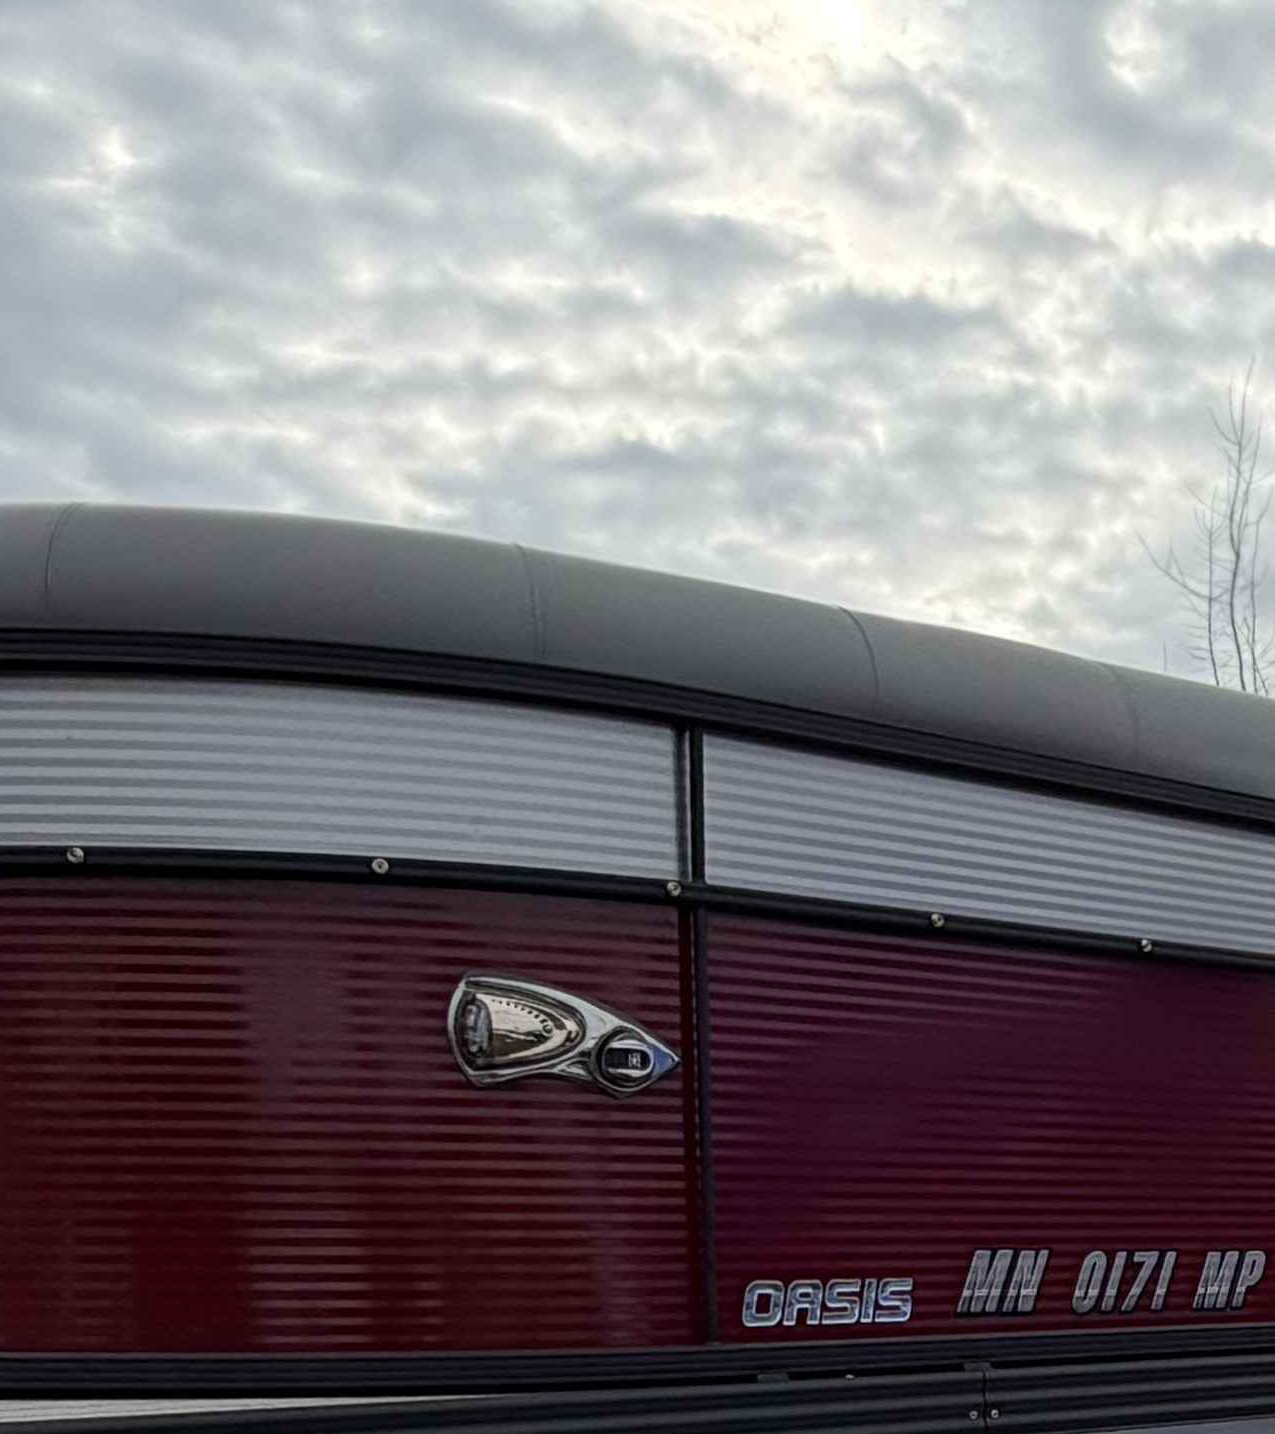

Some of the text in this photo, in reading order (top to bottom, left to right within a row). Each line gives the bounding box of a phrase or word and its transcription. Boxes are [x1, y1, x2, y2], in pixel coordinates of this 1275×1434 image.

[741, 1277, 915, 1327] OASIS
[956, 1250, 1266, 1313] MN 0171 MP
